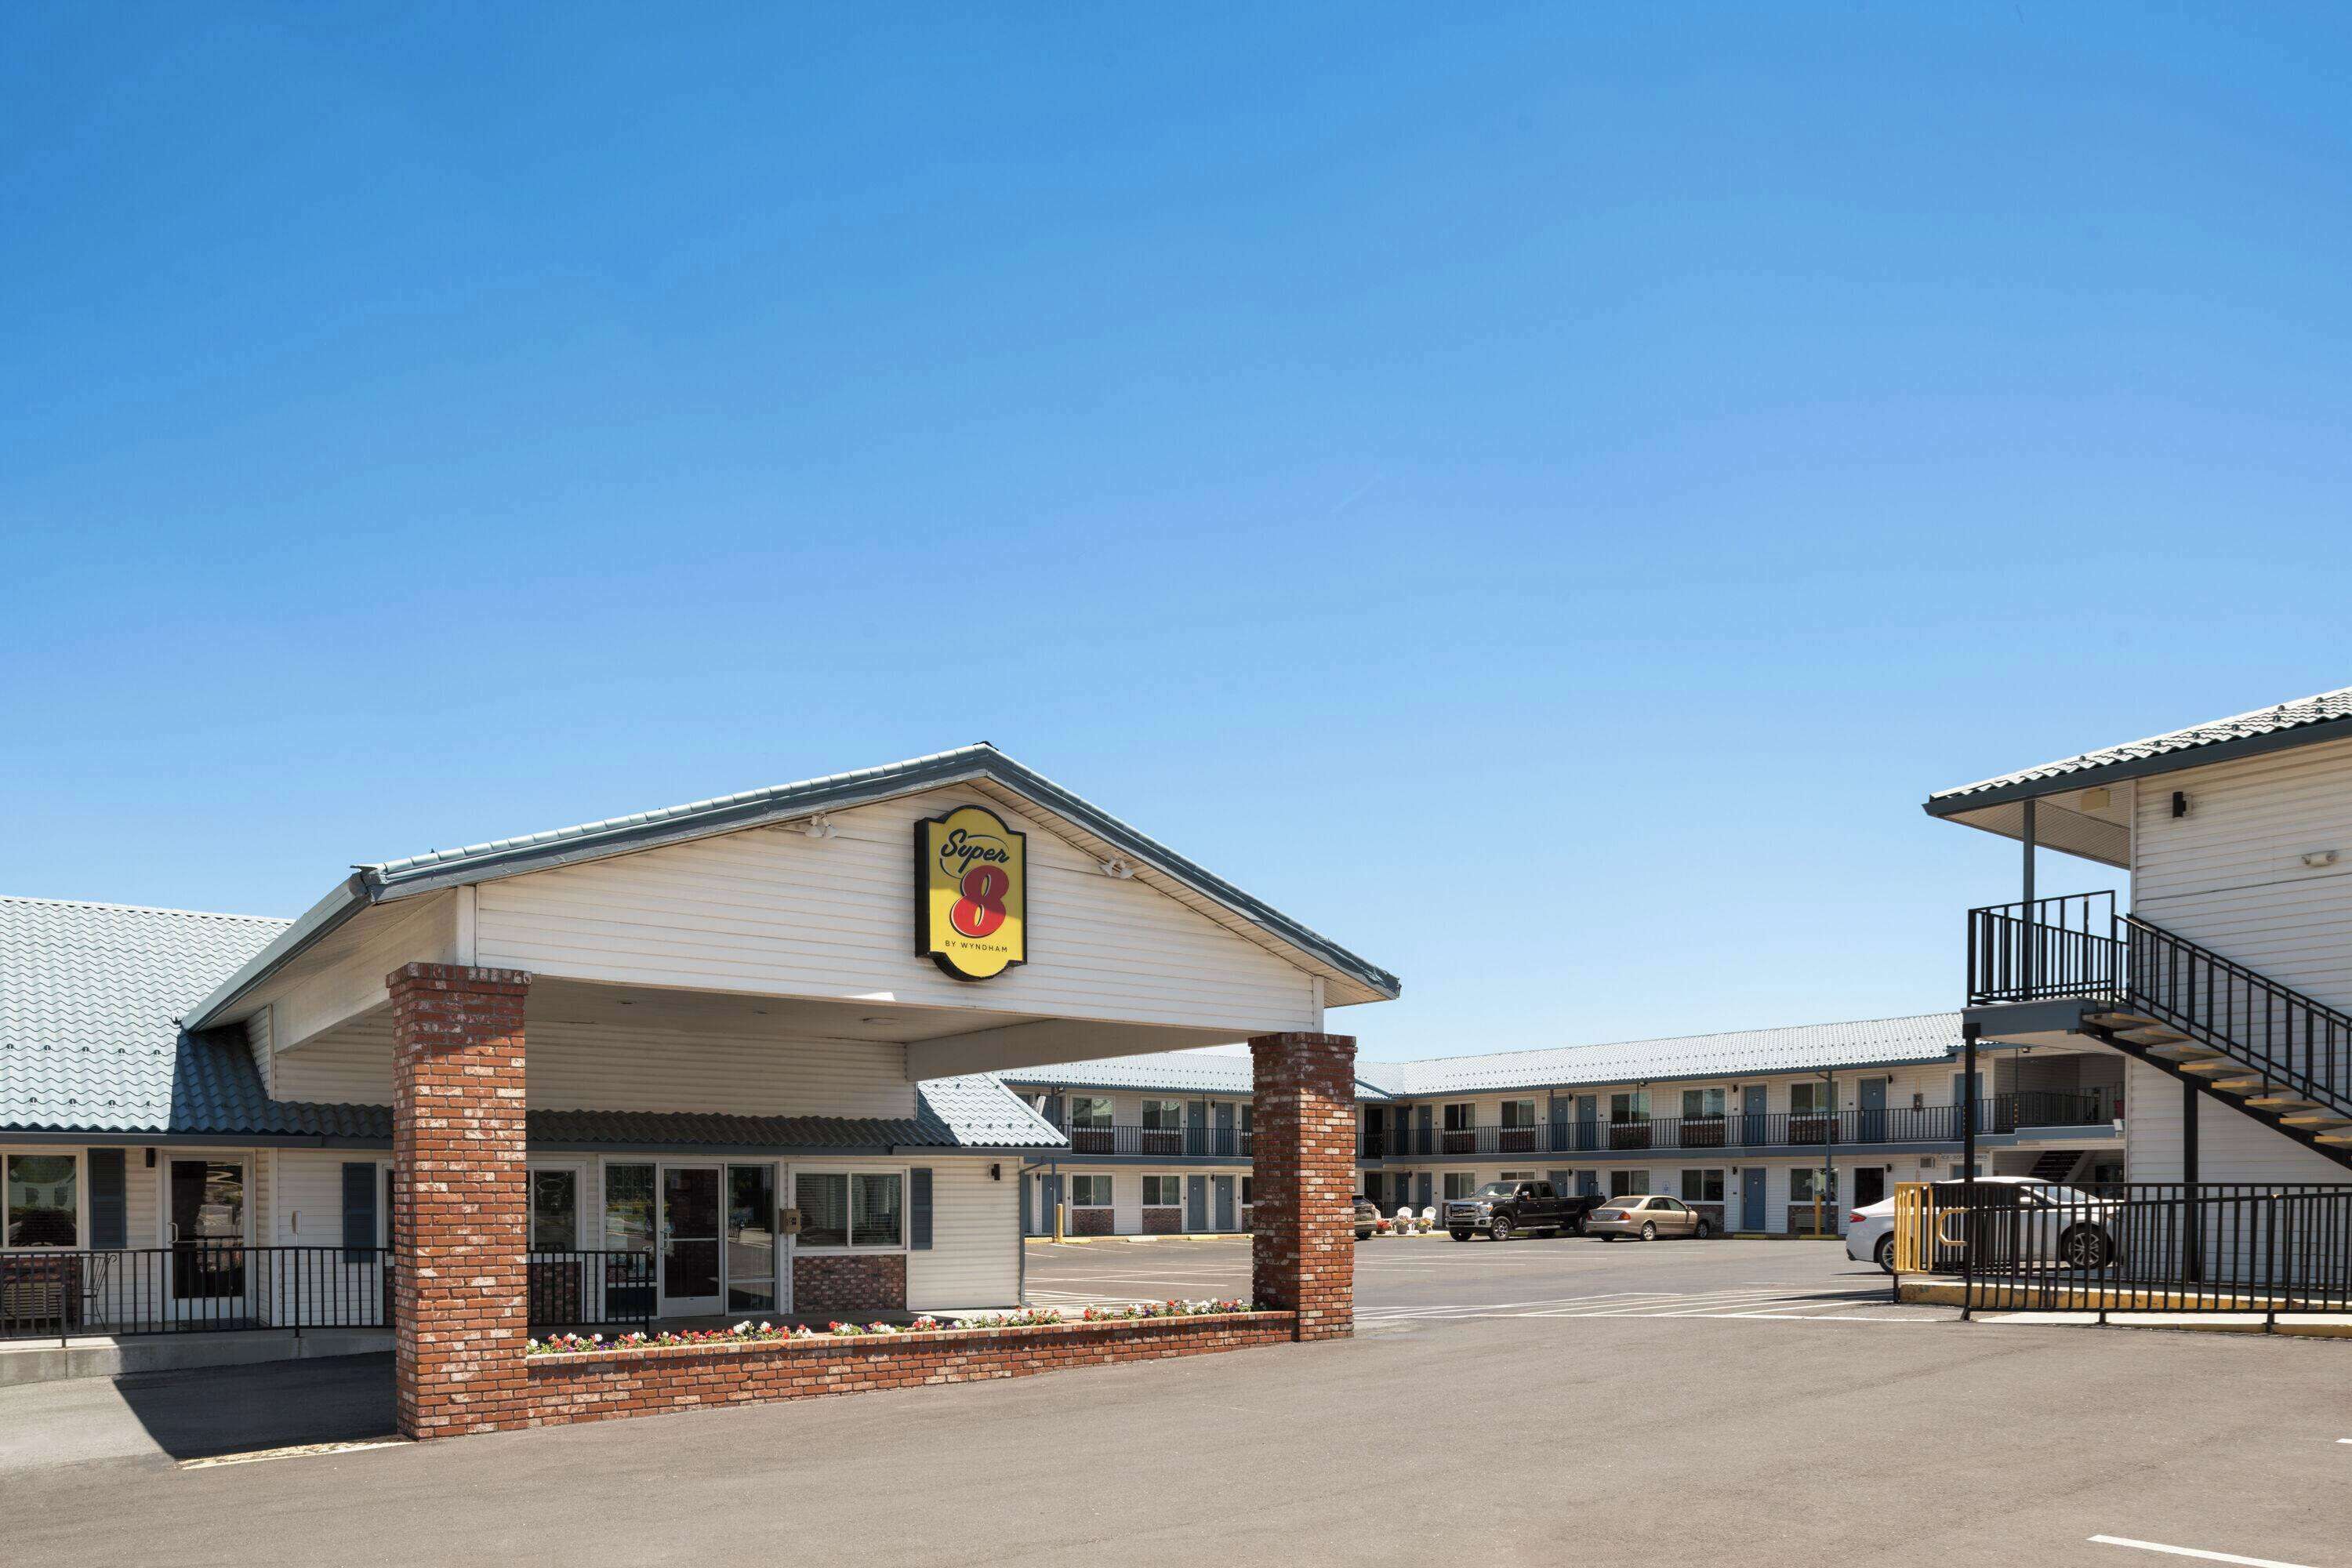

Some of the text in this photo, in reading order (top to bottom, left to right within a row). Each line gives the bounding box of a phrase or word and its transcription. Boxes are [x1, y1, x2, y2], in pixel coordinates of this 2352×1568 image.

[941, 828, 1010, 873] Super
[949, 865, 1010, 938] 8
[960, 942, 1008, 953] WYNDHAM
